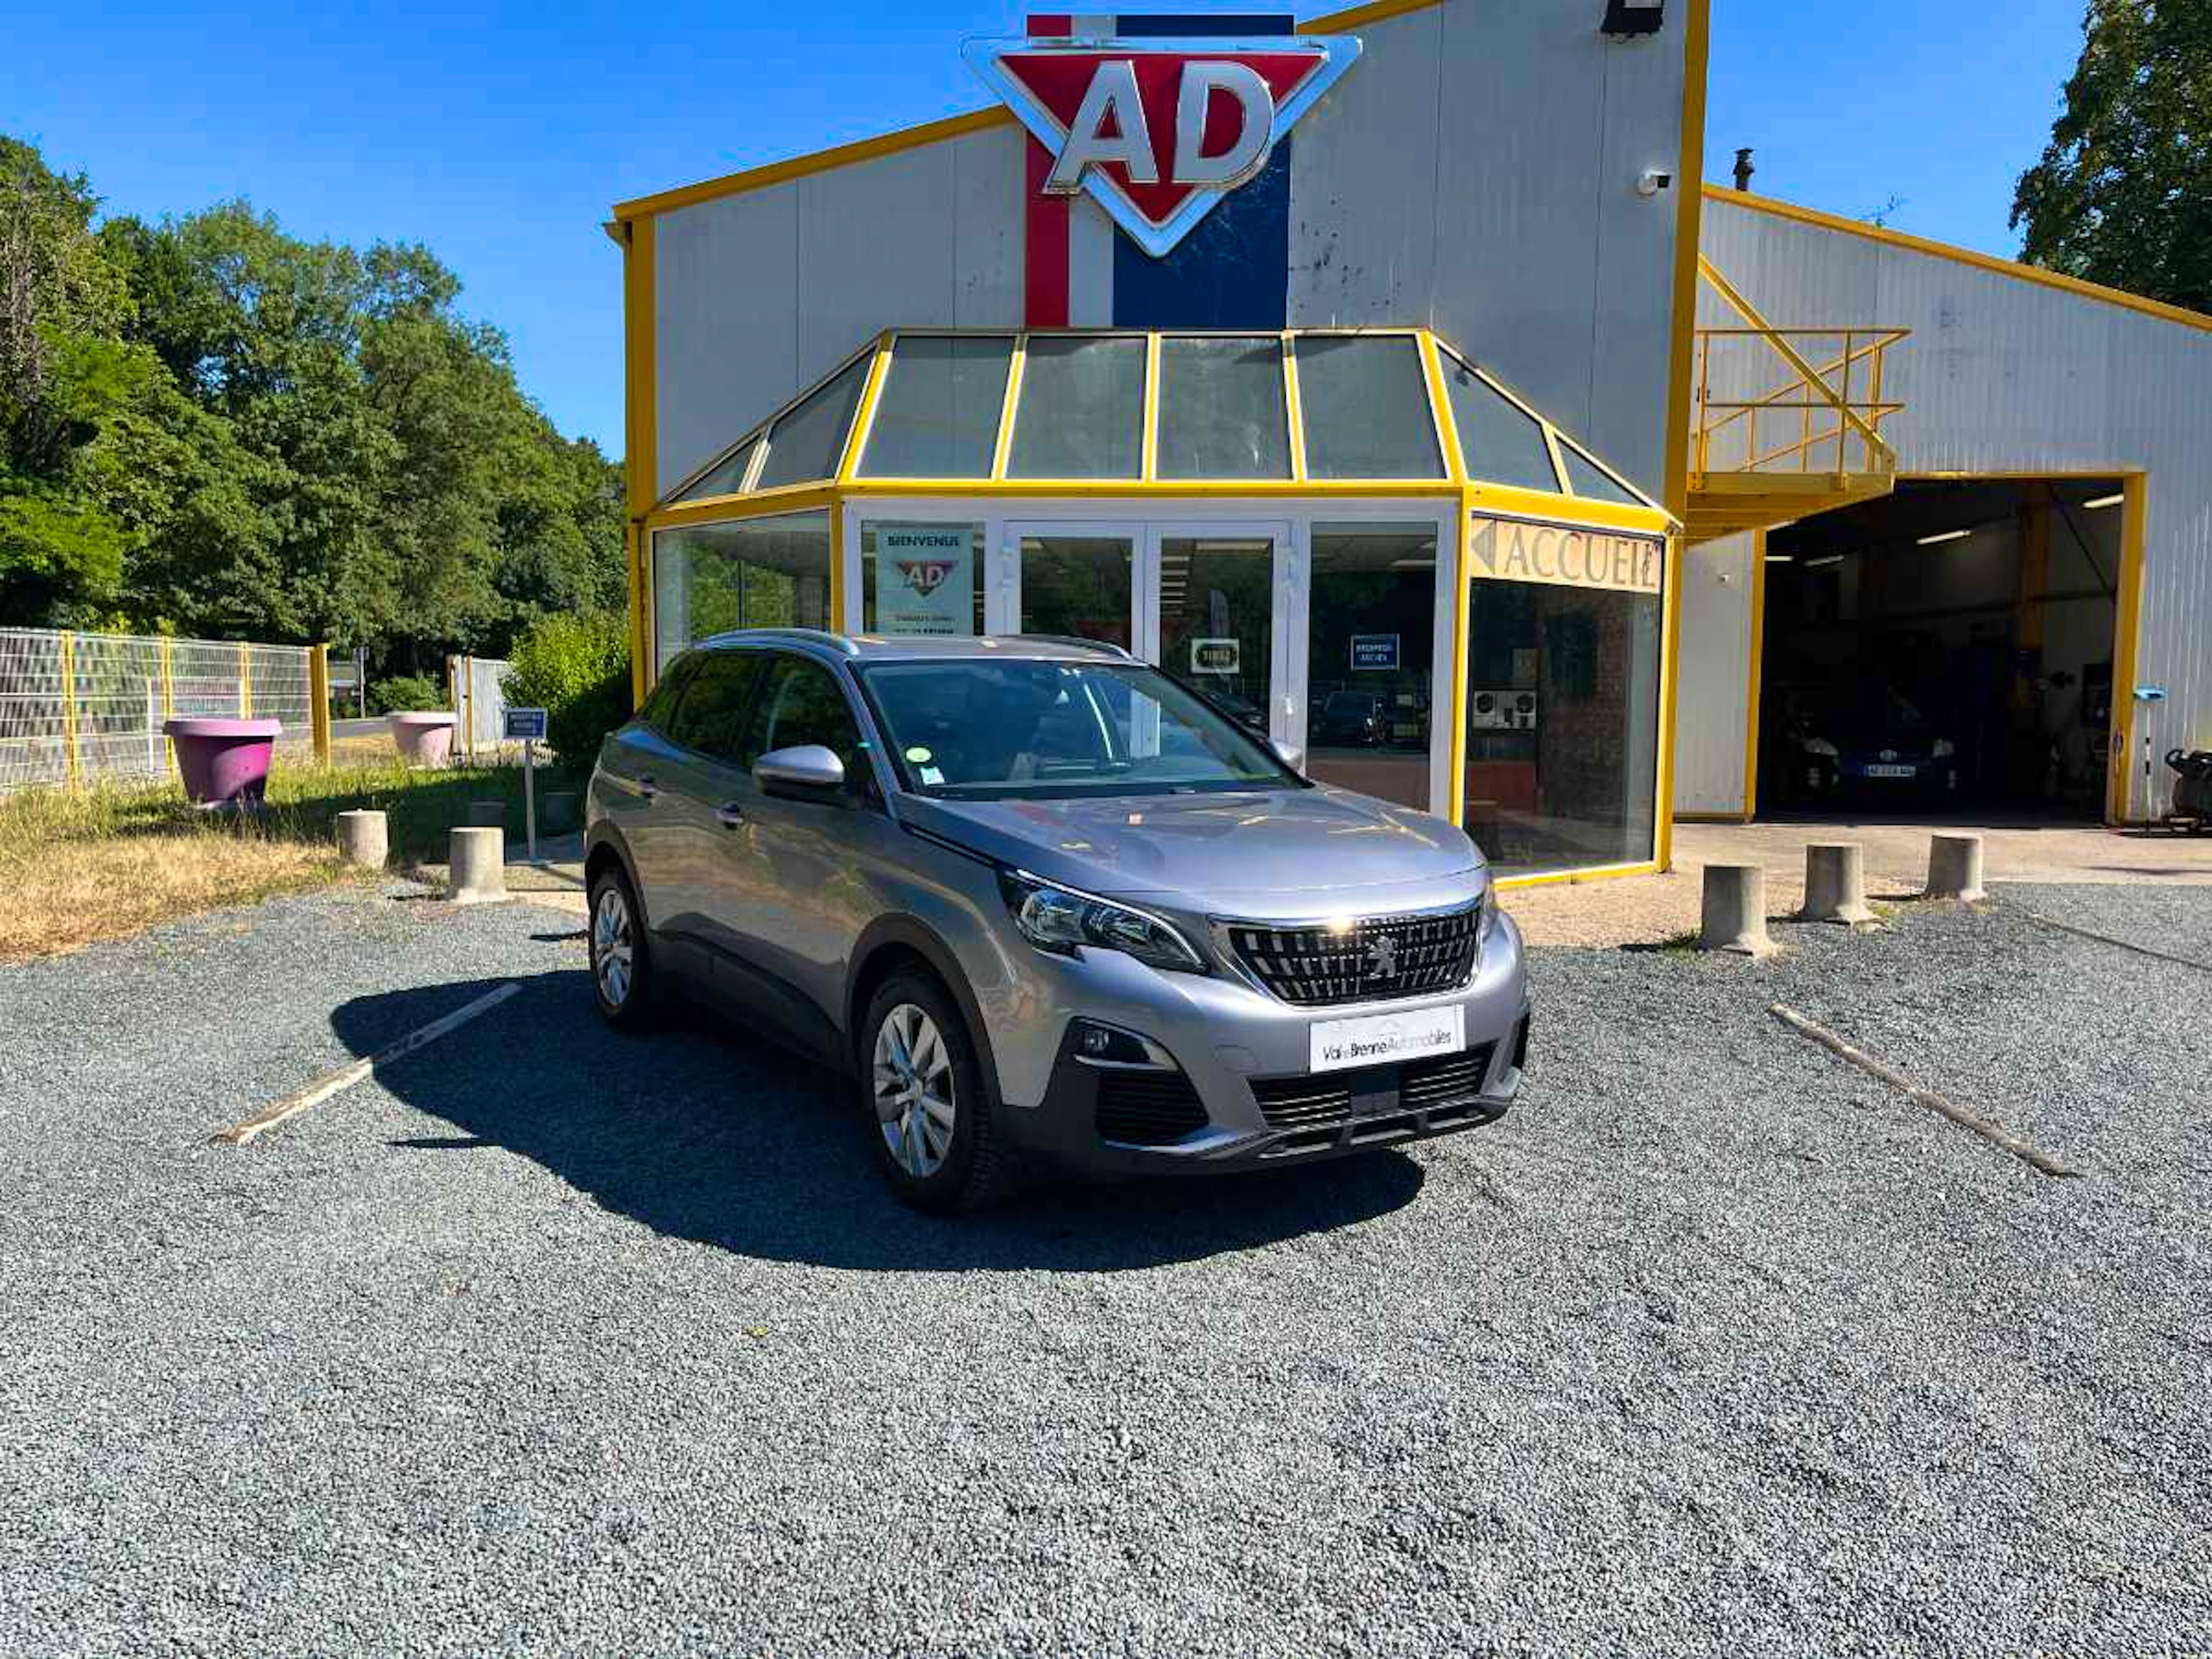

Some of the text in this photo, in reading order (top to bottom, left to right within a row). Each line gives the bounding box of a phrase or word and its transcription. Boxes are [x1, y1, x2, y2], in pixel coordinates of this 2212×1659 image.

[1043, 60, 1274, 195] AD
[888, 536, 959, 546] BIENVENUE
[1504, 525, 1656, 587] ACCUEIL
[902, 565, 945, 589] AD
